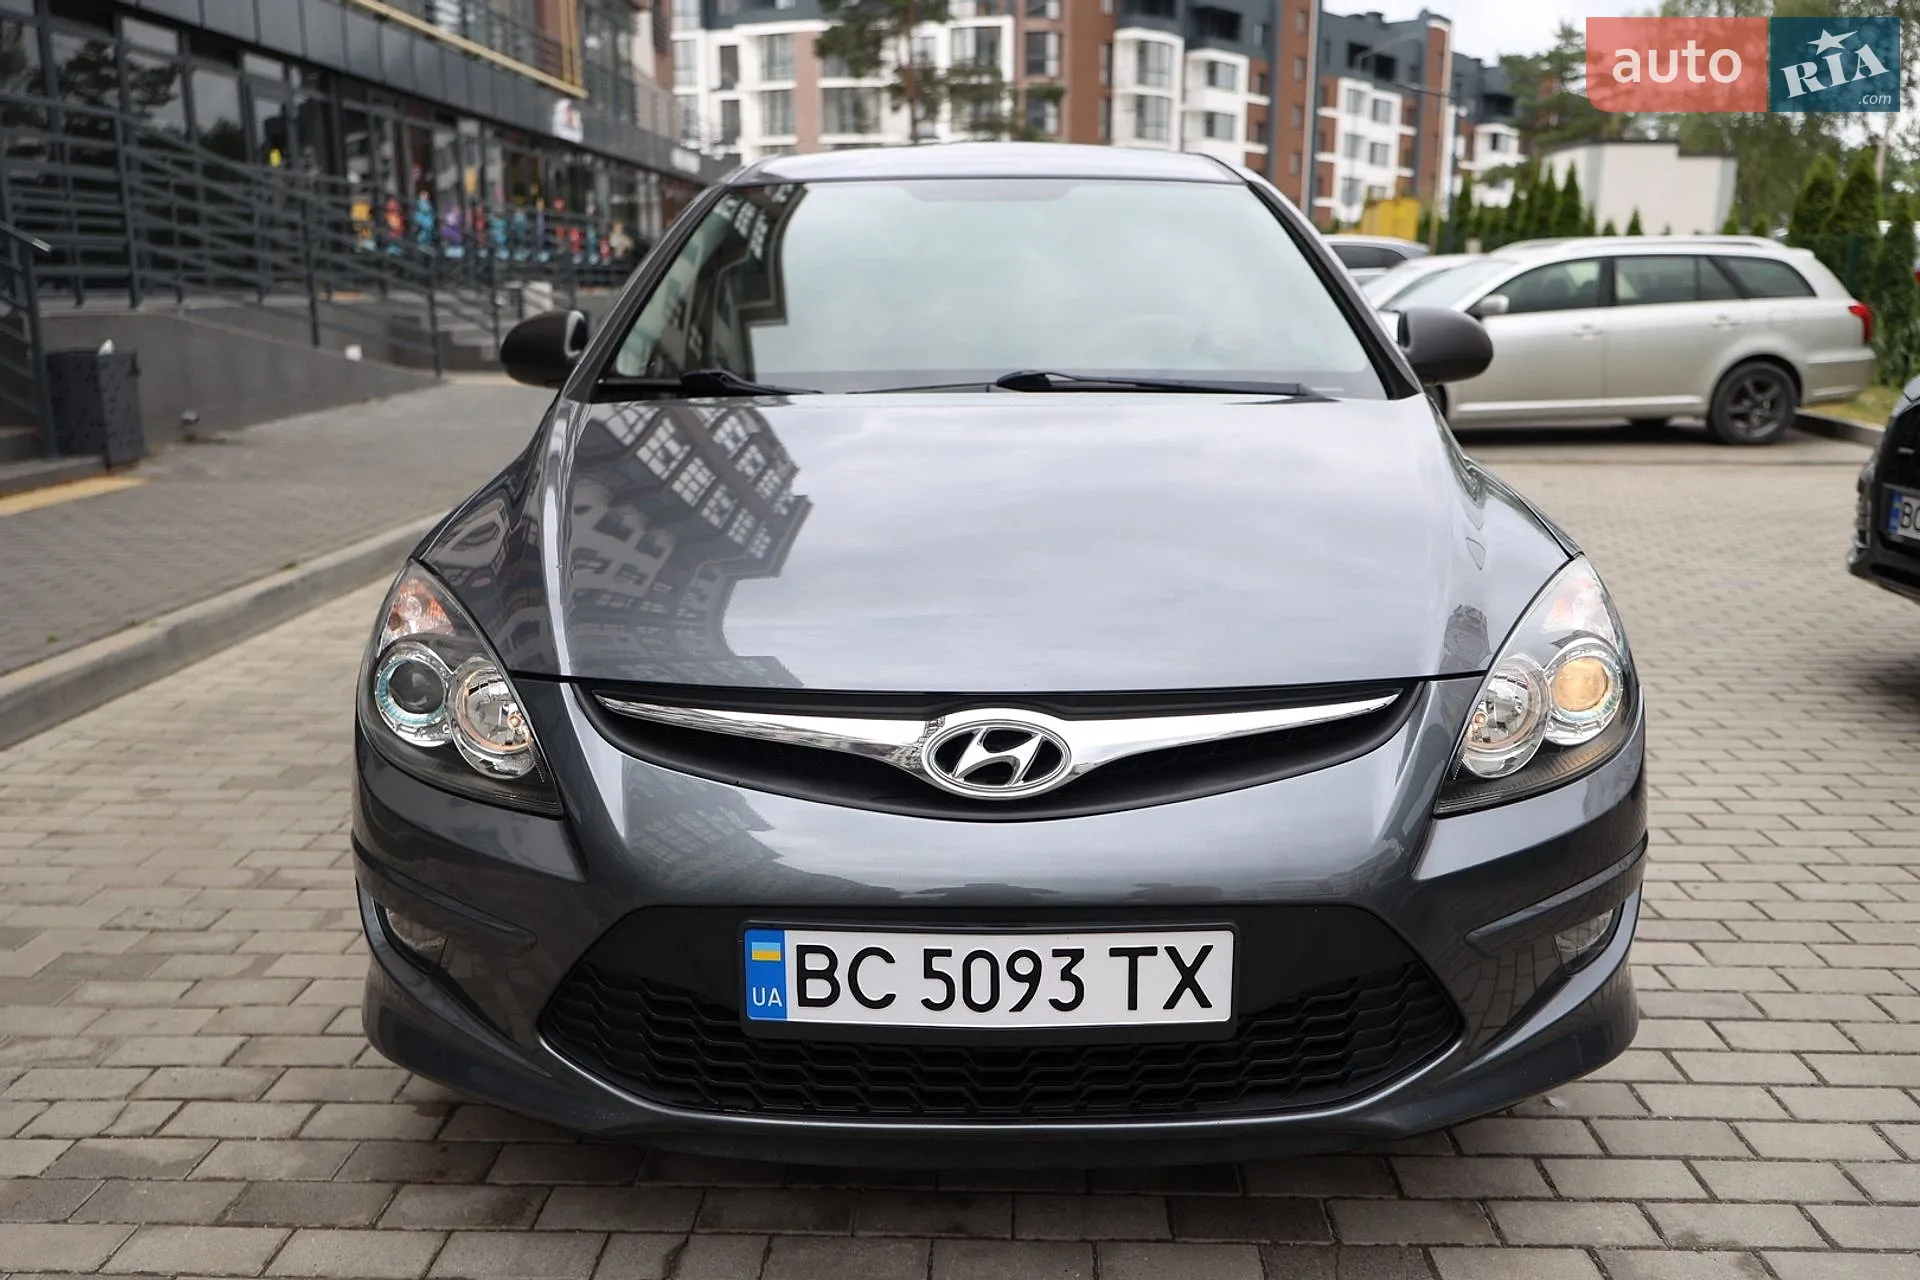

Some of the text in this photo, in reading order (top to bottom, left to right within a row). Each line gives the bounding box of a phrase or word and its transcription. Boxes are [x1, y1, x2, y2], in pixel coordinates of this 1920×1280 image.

[752, 987, 783, 1008] UA
[796, 944, 1214, 1013] BC 5093 TX
